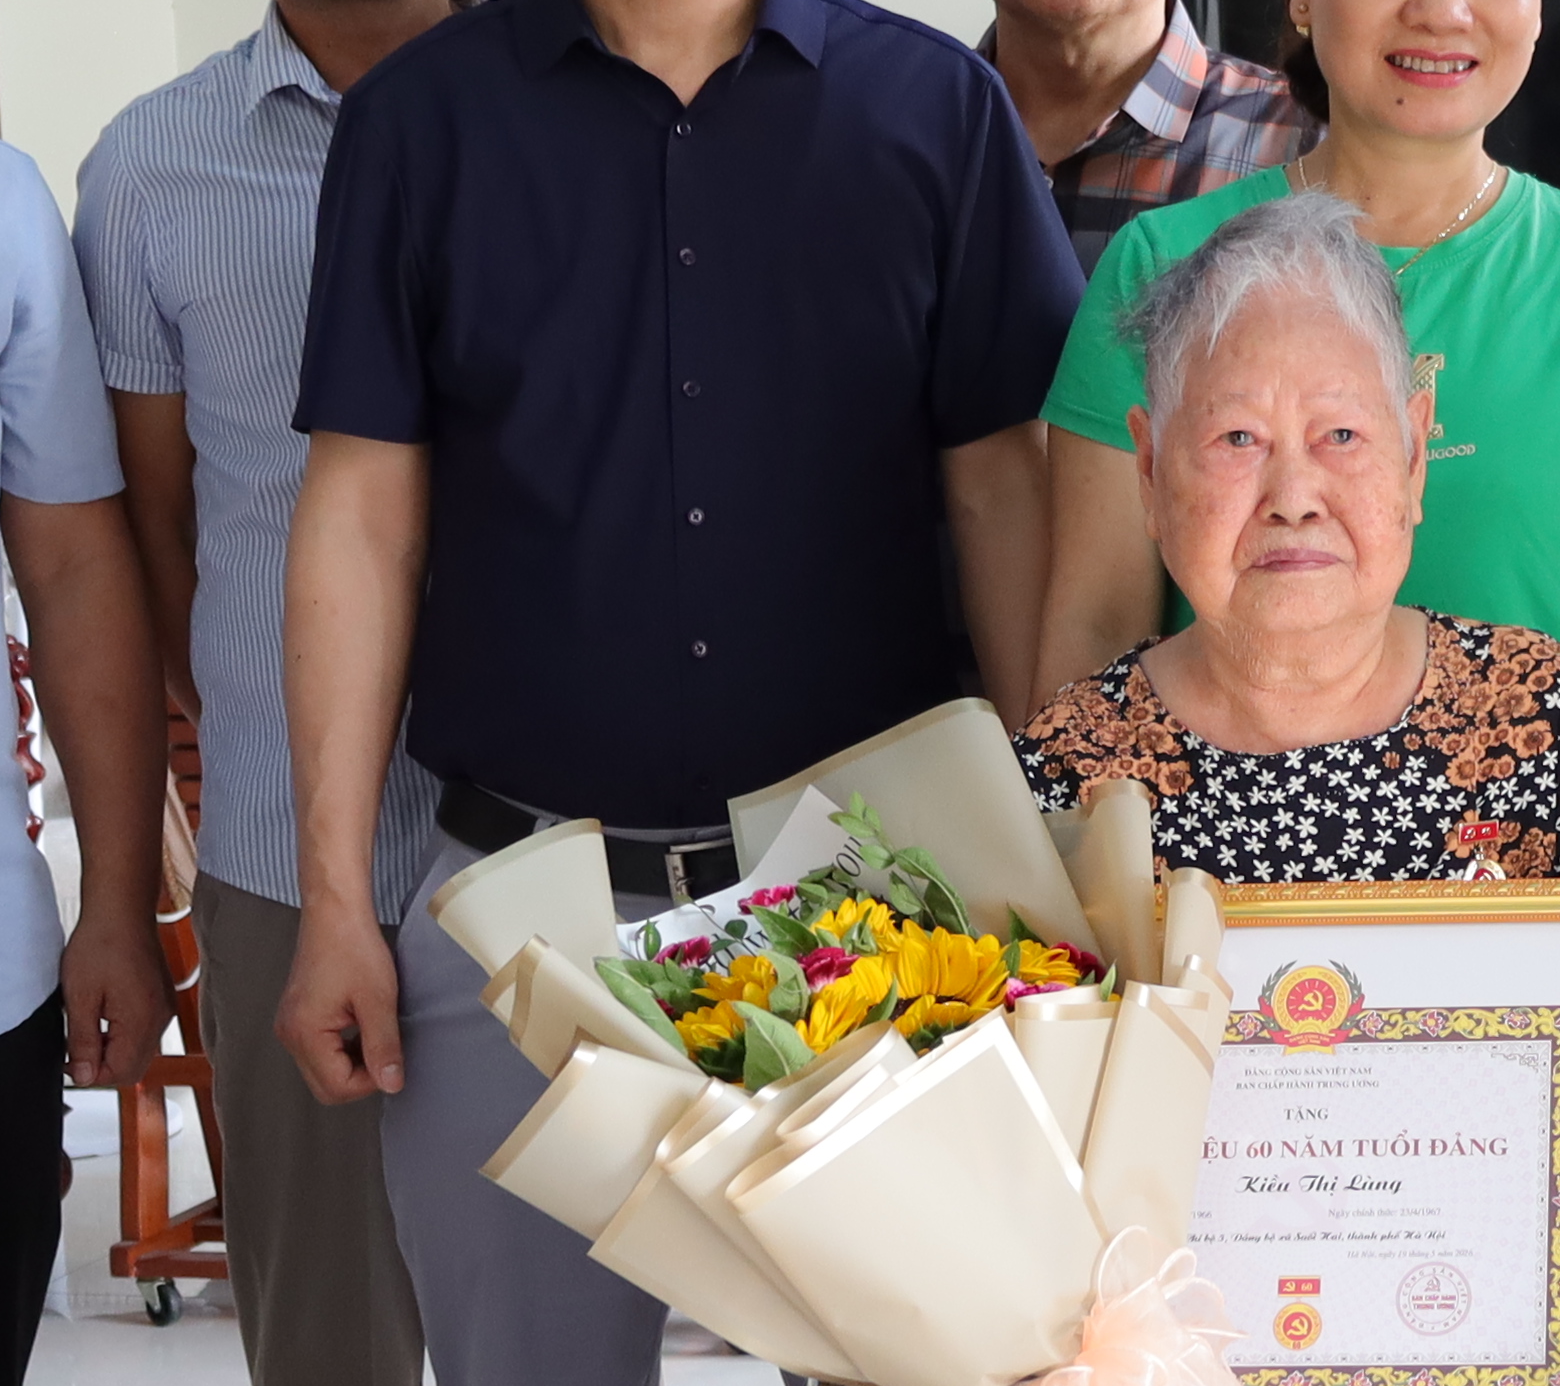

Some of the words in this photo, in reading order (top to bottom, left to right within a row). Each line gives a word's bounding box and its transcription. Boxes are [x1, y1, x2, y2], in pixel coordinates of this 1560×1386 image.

[1349, 1067, 1372, 1075] NAM
[1316, 1080, 1349, 1088] TRUNG
[1284, 1105, 1329, 1123] TẶNG
[1246, 1140, 1273, 1159] 60
[1280, 1134, 1344, 1159] NĂM
[1352, 1129, 1421, 1157] TUỔI
[1429, 1132, 1509, 1156] ĐẢNG
[1235, 1174, 1290, 1193] Kiều
[1299, 1175, 1339, 1197] Thị
[1328, 1209, 1350, 1219] Ngày
[1301, 1282, 1313, 1291] 60
